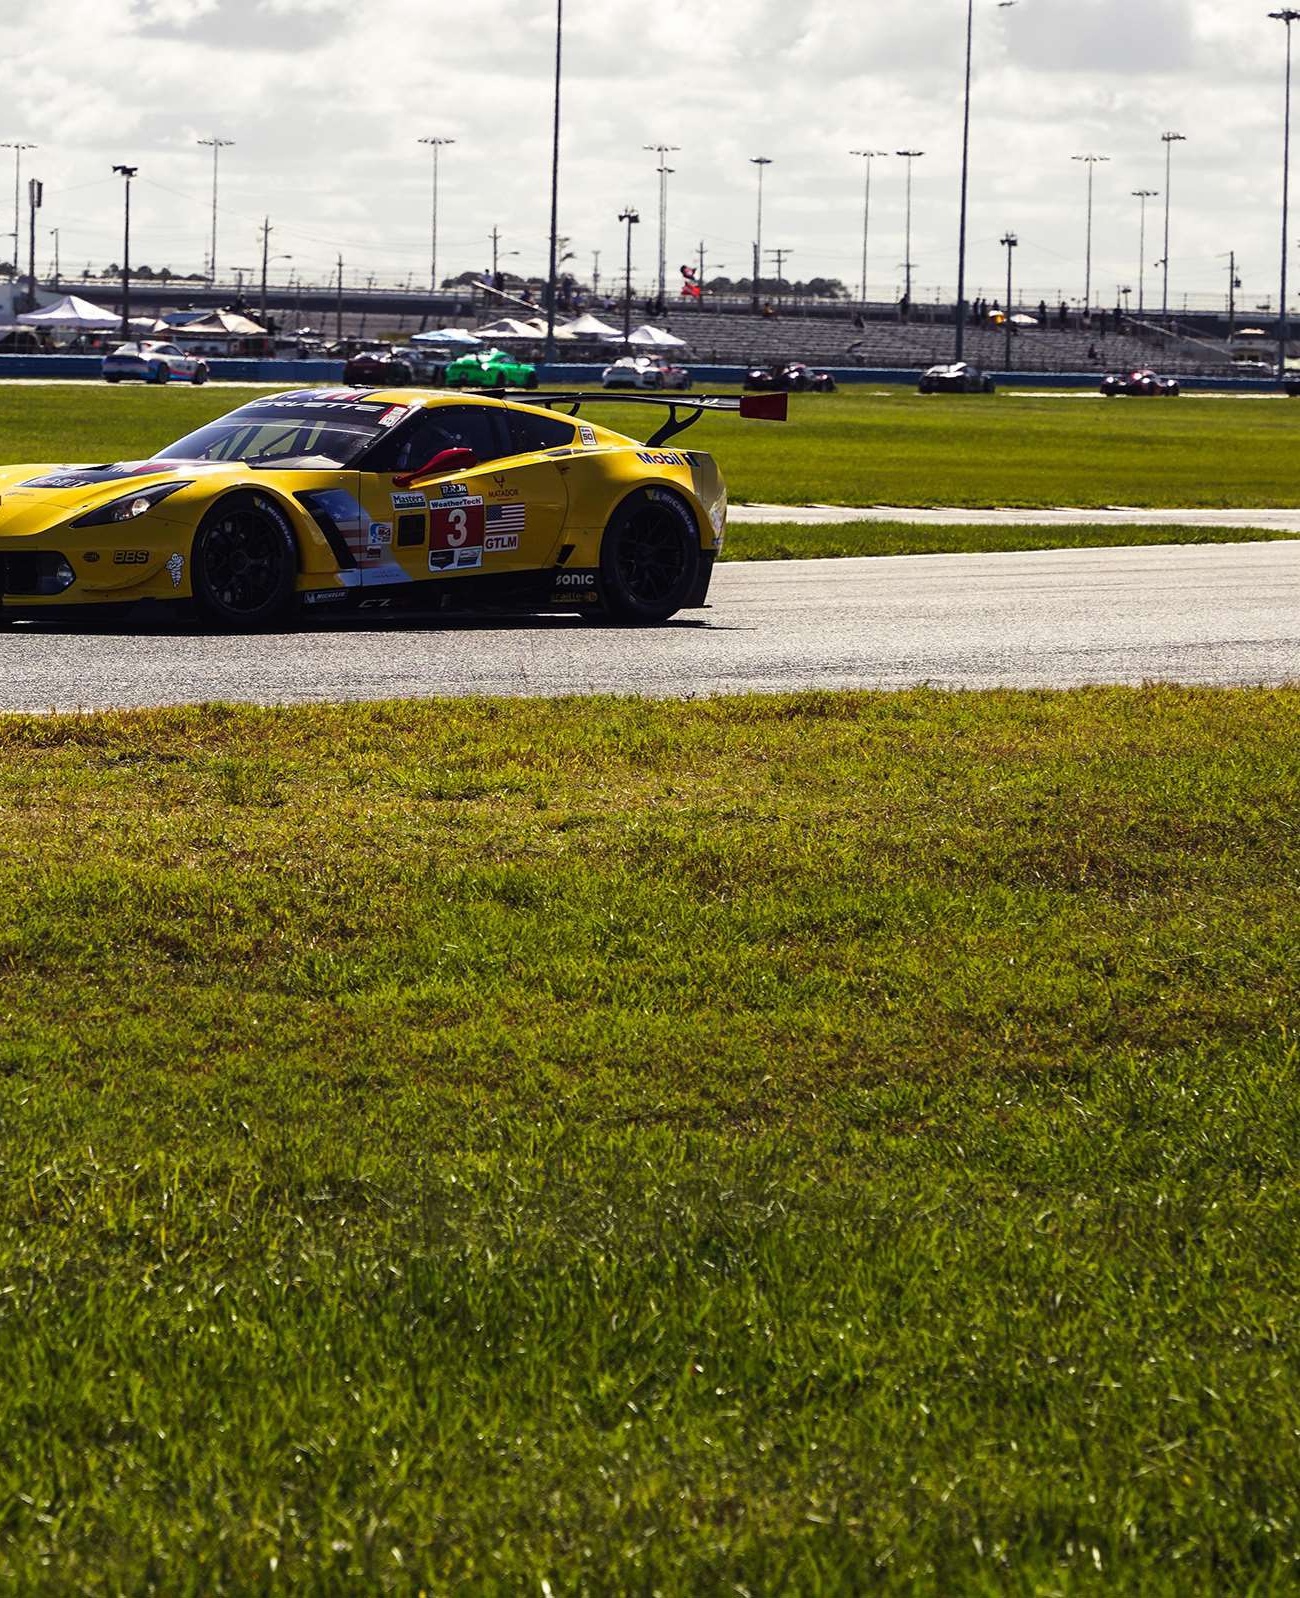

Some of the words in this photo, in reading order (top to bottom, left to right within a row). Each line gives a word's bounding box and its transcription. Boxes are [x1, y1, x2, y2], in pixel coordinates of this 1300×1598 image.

[636, 452, 684, 466] Mobil
[393, 494, 425, 504] Masters
[431, 497, 482, 509] WeatherTech
[447, 508, 468, 547] 3
[486, 535, 517, 549] GTLM
[113, 550, 149, 564] BBS
